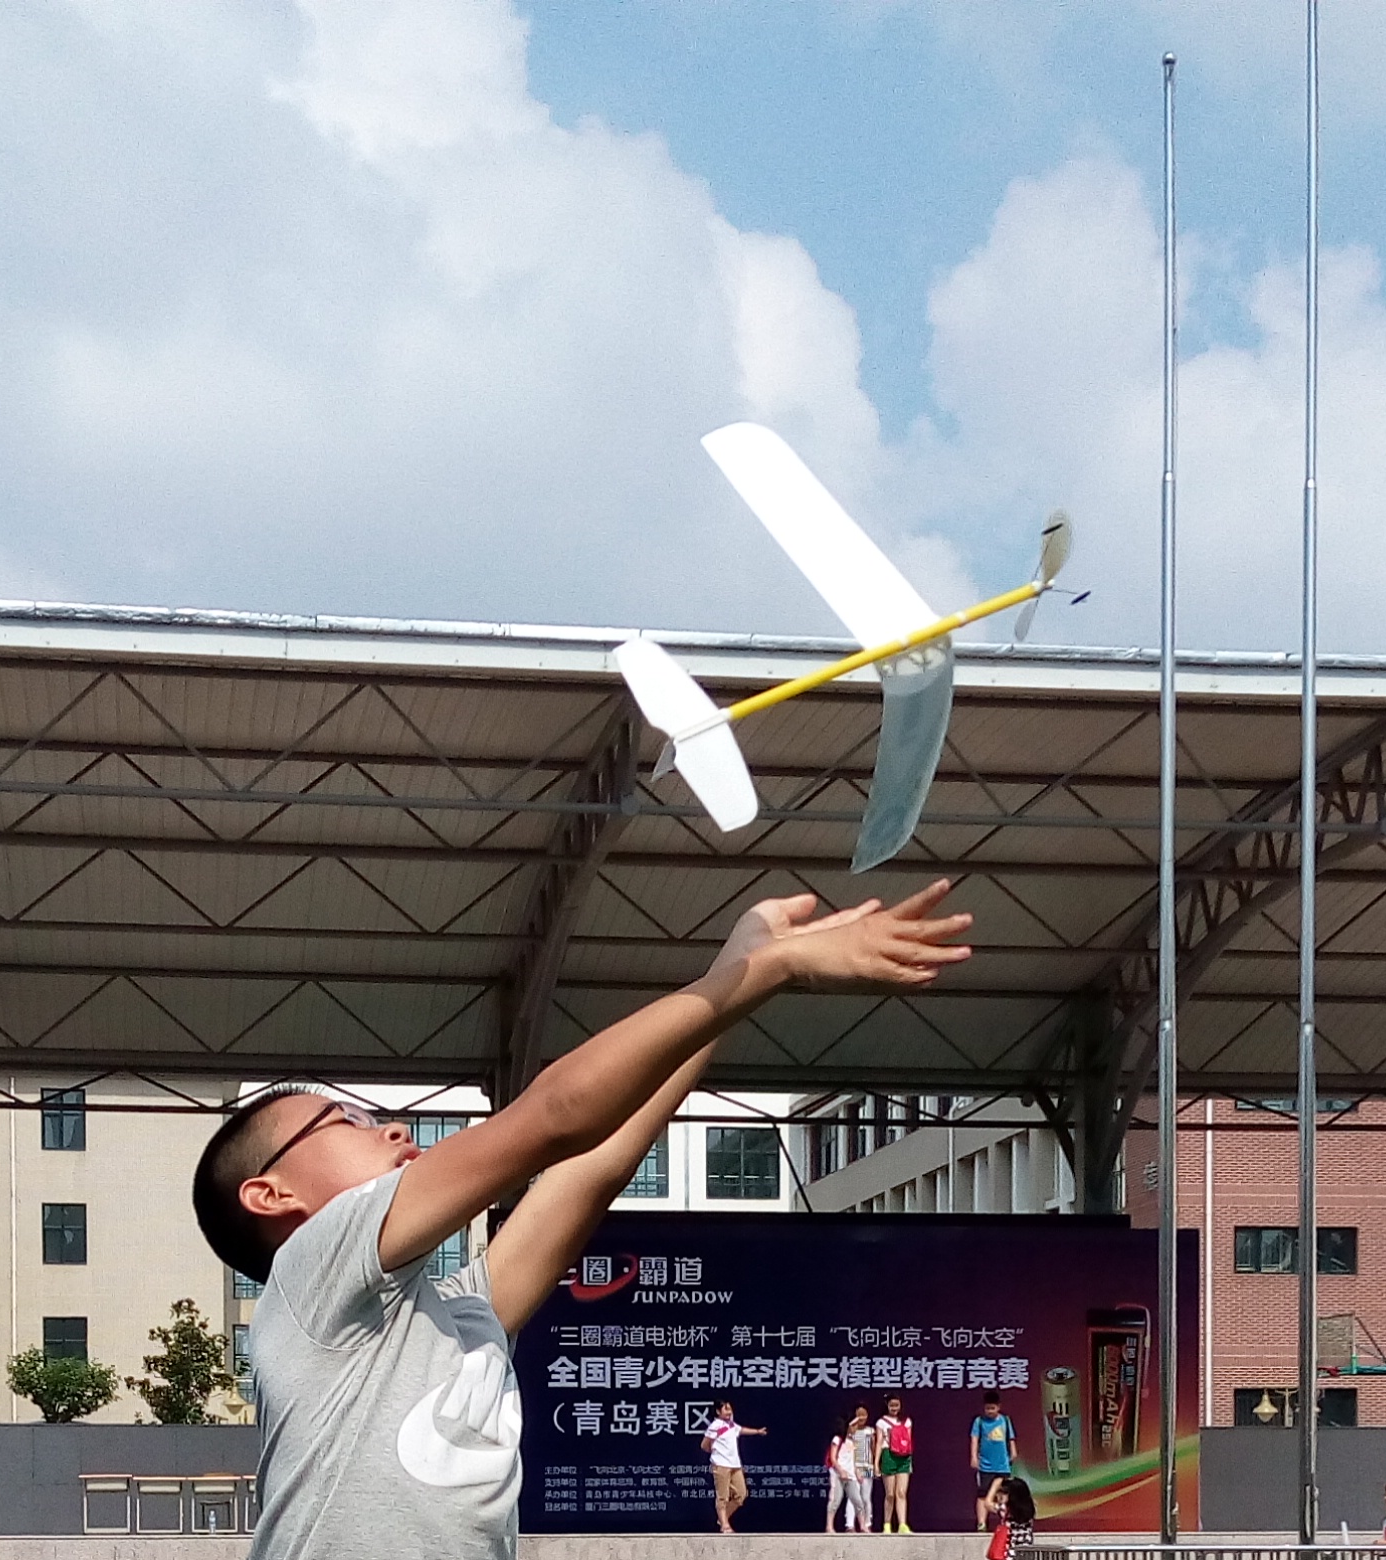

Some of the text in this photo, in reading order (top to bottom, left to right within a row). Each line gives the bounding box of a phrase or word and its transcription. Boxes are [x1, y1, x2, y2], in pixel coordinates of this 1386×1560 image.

[631, 1290, 734, 1304] SUNPADOW
[547, 1356, 1030, 1389] 全国青少年航空航天模型教育竞赛
